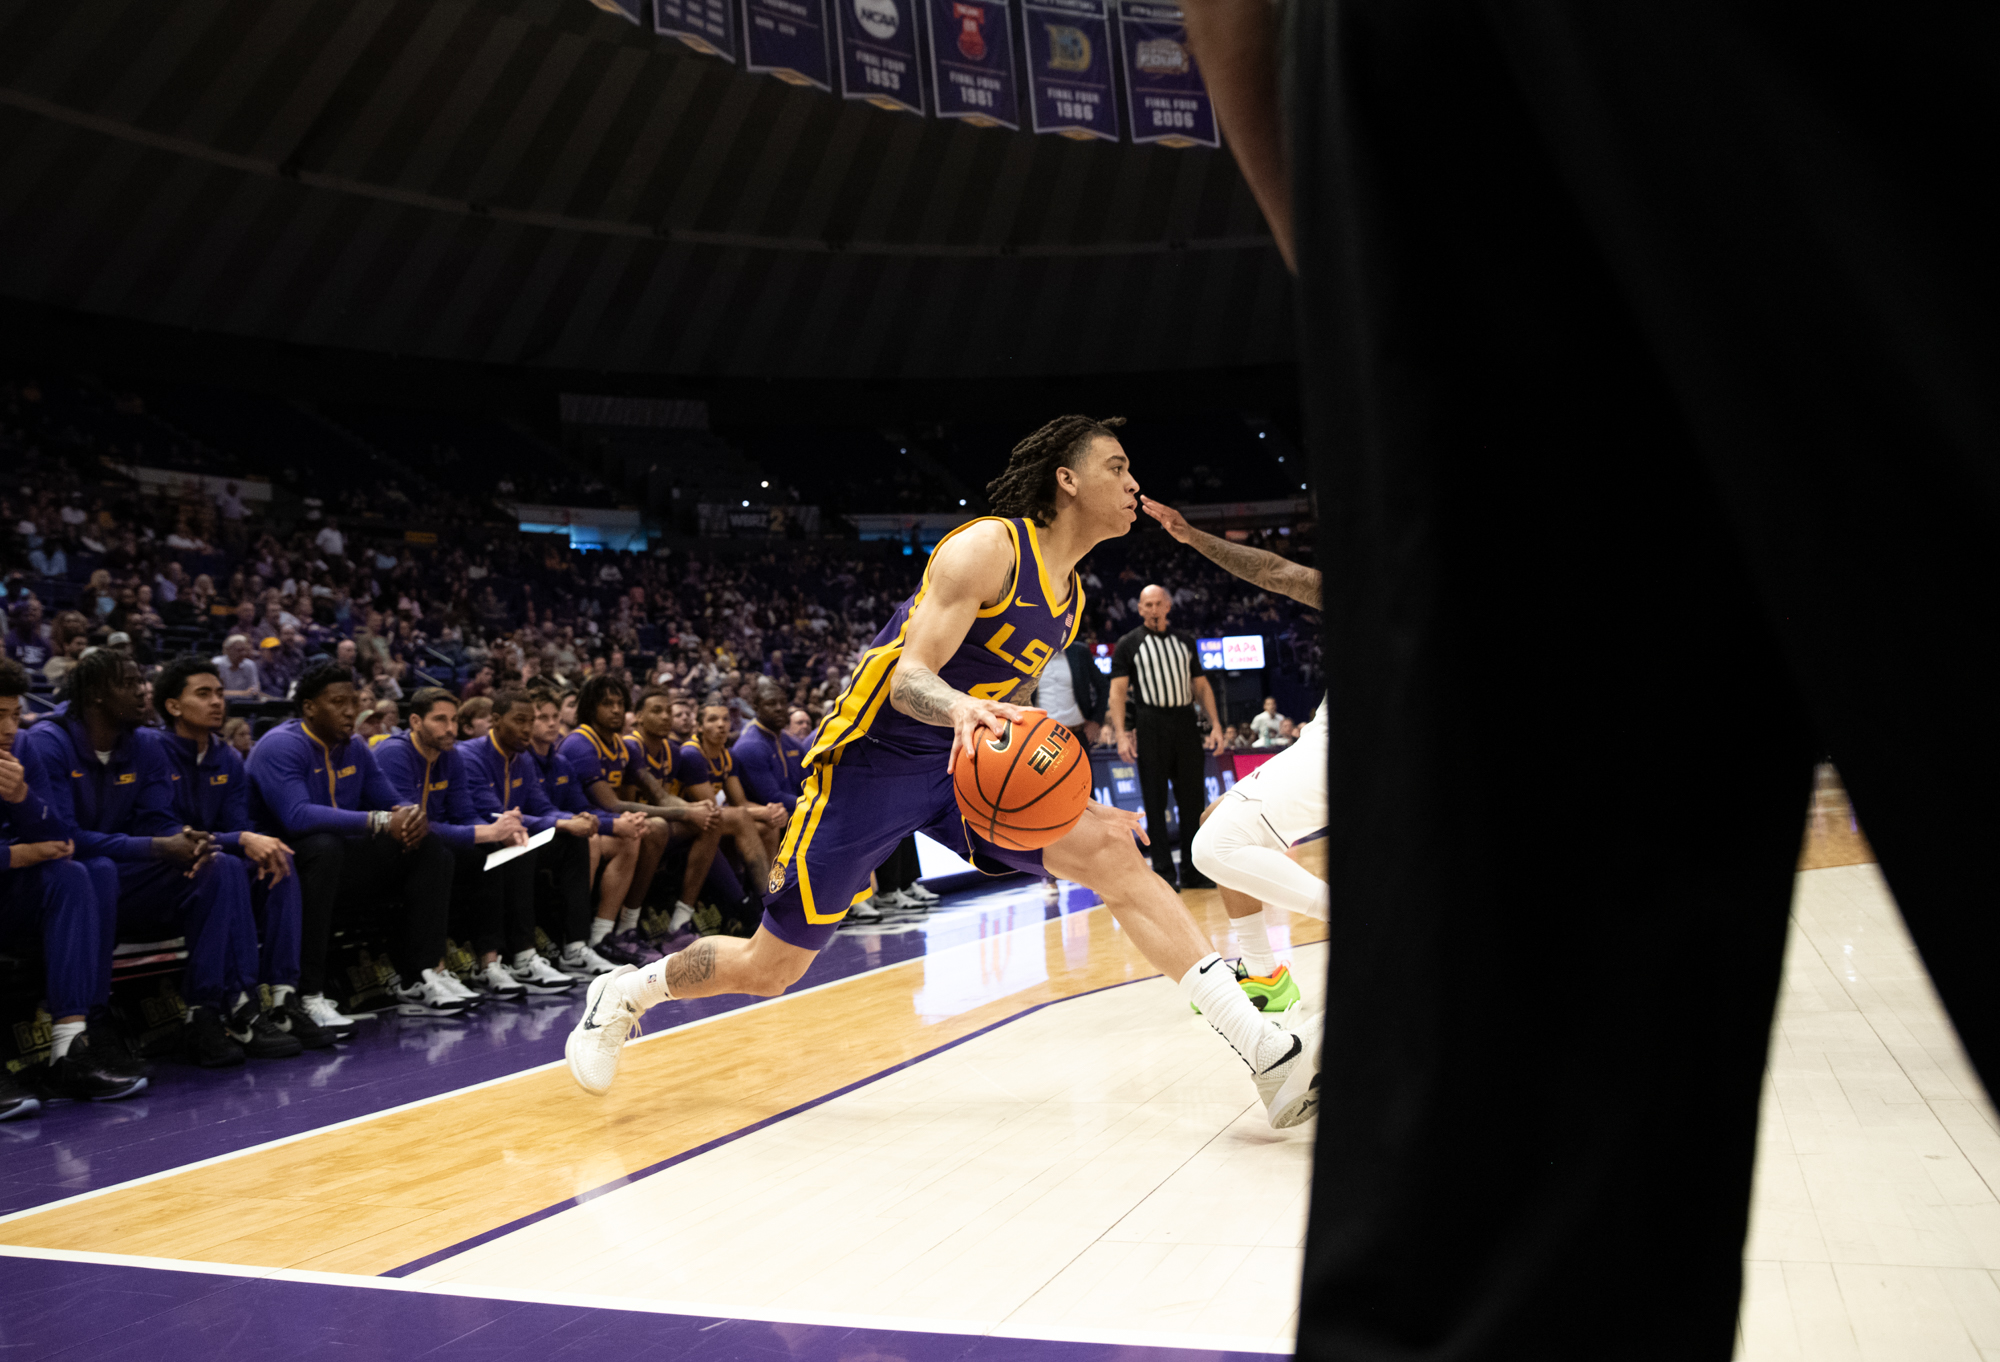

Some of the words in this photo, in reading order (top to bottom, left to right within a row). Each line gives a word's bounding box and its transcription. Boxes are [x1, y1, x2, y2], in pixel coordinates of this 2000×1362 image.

[861, 8, 897, 28] NCAA
[856, 50, 880, 67] FINAL
[882, 57, 906, 73] FOUR
[865, 66, 900, 90] 1953
[949, 71, 975, 87] FINAL
[976, 75, 1001, 91] FOUR
[960, 87, 994, 107] 1981
[1047, 87, 1073, 101] FINAL
[1075, 90, 1100, 104] FOUR
[1145, 97, 1171, 109] FINAL
[1173, 99, 1198, 111] FOUR
[1056, 101, 1094, 121] 1986
[1152, 110, 1194, 128] 2006
[770, 506, 786, 532] 2
[1201, 641, 1222, 651] LSU
[1203, 652, 1223, 669] 34
